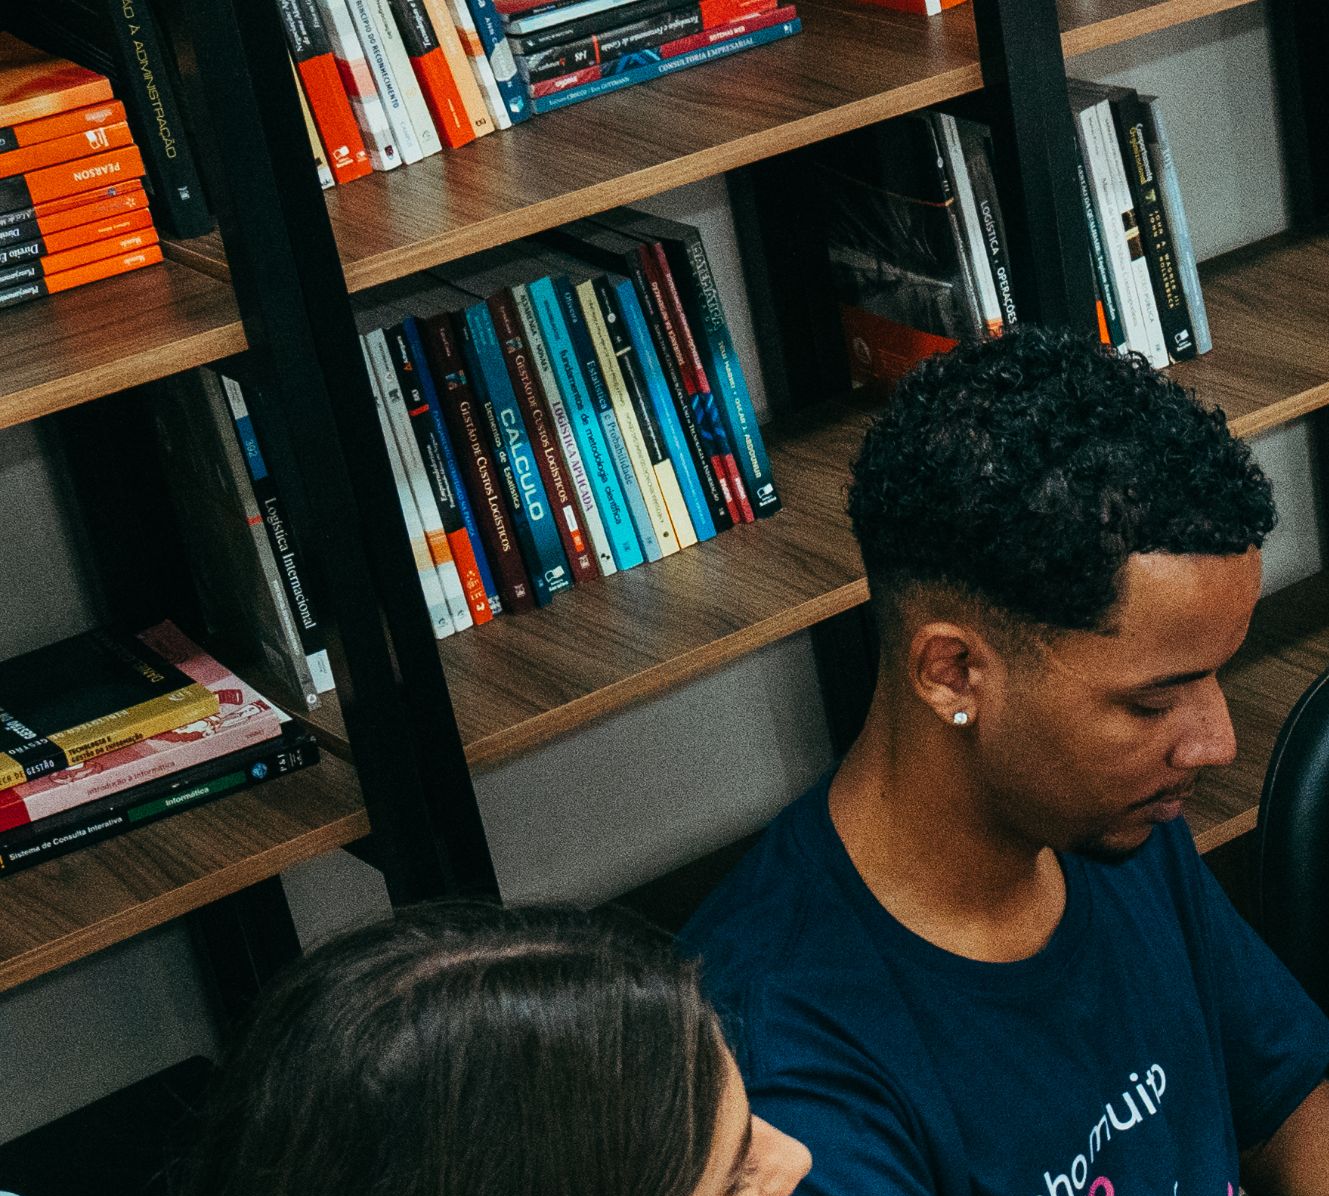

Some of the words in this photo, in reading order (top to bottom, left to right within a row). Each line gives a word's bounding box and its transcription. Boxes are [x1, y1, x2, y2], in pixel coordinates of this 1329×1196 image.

[366, 32, 376, 44] DO
[373, 44, 399, 108] RECONHECIMENTO
[657, 51, 707, 73] CONSULTORIA
[706, 37, 754, 58] EMPRESARIAL
[132, 39, 178, 159] ADMINISTRAÇÃO
[73, 159, 120, 182] PEARSON
[1136, 123, 1153, 181] Comportamento
[8, 243, 39, 260] Direito
[980, 200, 999, 255] LOGÍSTICA
[996, 266, 1018, 324] OPERAÇÕES
[560, 291, 581, 323] Oliveira
[516, 353, 535, 395] GESTÃO
[558, 349, 584, 408] fundamentos
[458, 401, 479, 441] GESTÃO
[527, 395, 538, 409] DE
[579, 412, 591, 425] de
[733, 397, 747, 422] OSCAR
[532, 408, 551, 448] CUSTOS
[586, 359, 608, 409] Estatística
[609, 421, 634, 486] Probabilidade
[244, 439, 258, 457] 392
[470, 442, 482, 456] DE
[483, 401, 502, 446] Elementos
[498, 450, 508, 463] de
[503, 465, 521, 508] Estatística
[552, 401, 578, 458] LOGÍSTICA
[571, 458, 594, 512] APLICADA
[581, 426, 607, 484] metodologia
[475, 454, 497, 494] CUSTOS
[545, 457, 568, 503] LOGÍSTICOS
[487, 495, 512, 552] LOGÍSTICOS
[603, 485, 624, 524] científica
[264, 498, 290, 551] Logística
[282, 553, 316, 628] Internacional
[26, 758, 55, 775] GESTÃO
[164, 784, 210, 807] Informática
[8, 843, 40, 862] Sistema
[40, 839, 52, 850] de
[51, 827, 87, 847] Consulta
[86, 814, 123, 834] Interativa
